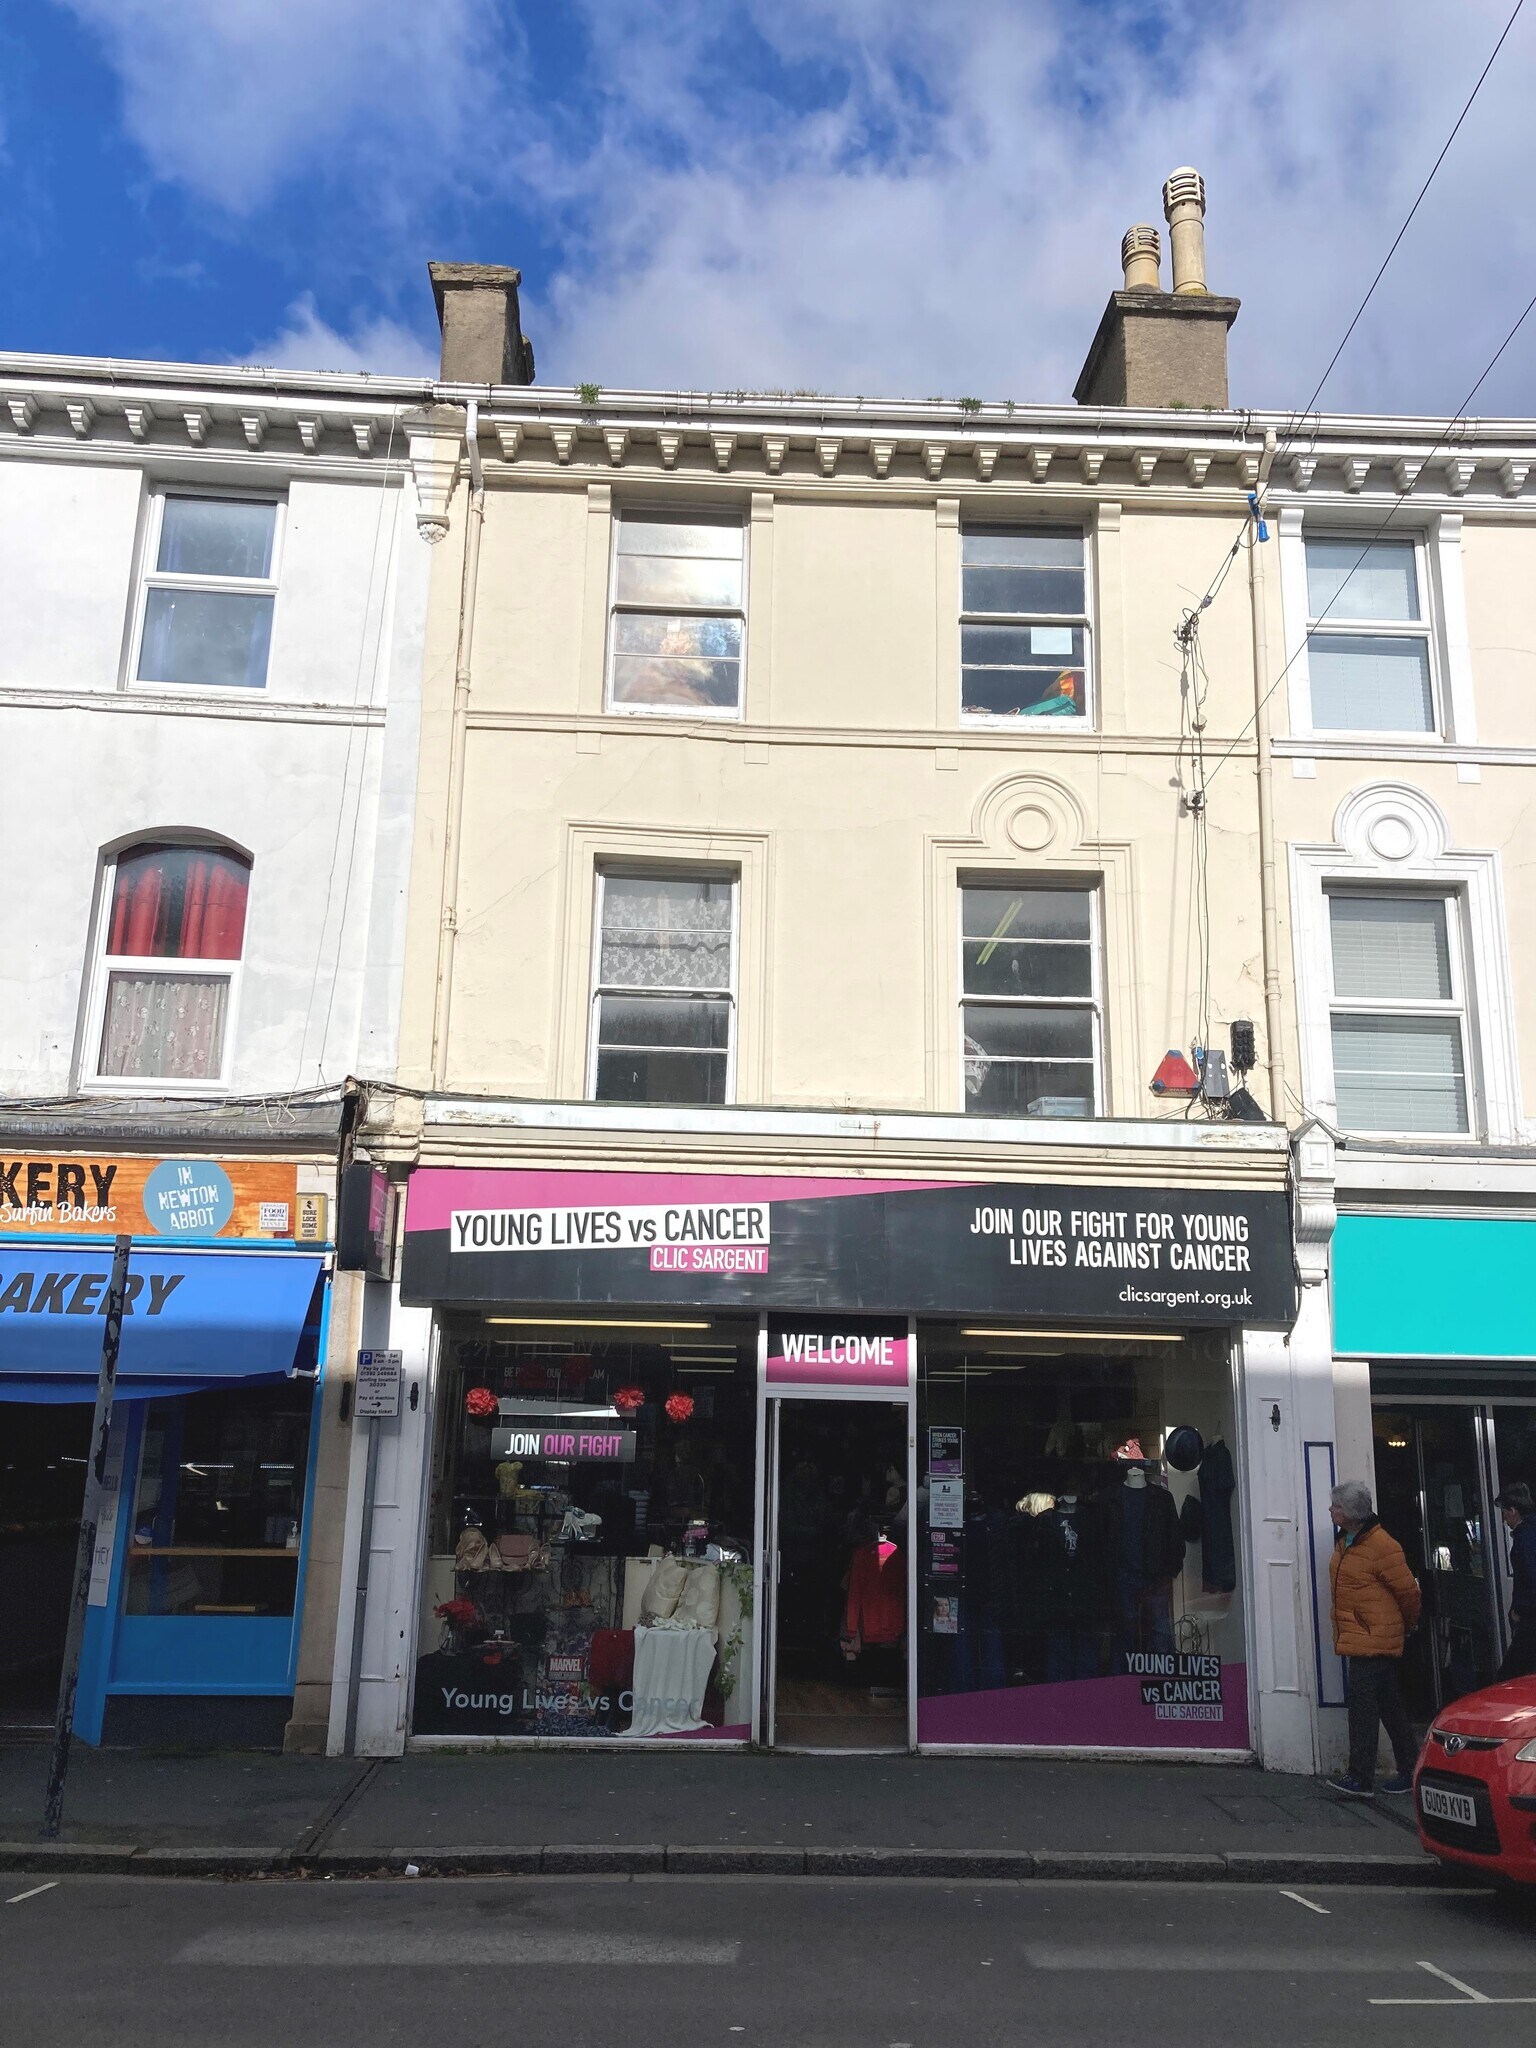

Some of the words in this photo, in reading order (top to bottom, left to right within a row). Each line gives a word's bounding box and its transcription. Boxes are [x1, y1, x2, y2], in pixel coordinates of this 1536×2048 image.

[0, 1162, 117, 1210] KERY
[178, 1166, 193, 1185] IN
[158, 1184, 220, 1211] NEWTON
[0, 1200, 53, 1225] Surfin
[57, 1200, 117, 1223] Bakers
[170, 1207, 215, 1231] ABBOT
[970, 1207, 1014, 1235] JOIN
[1022, 1208, 1062, 1237] OUR
[1070, 1210, 1128, 1239] FIGHT
[1136, 1213, 1176, 1240] FOR
[1181, 1213, 1249, 1242] YOUNG
[455, 1212, 542, 1247] YOUNG
[551, 1211, 621, 1244] LIVES
[628, 1218, 657, 1243] vs
[665, 1208, 764, 1241] CANCER
[653, 1248, 687, 1271] CLIC
[692, 1247, 766, 1271] SARGENT
[1009, 1238, 1067, 1267] LIVES
[1075, 1240, 1162, 1270] AGAINST
[1169, 1243, 1251, 1272] CANCER
[0, 1272, 186, 1316] AKERY
[1119, 1284, 1253, 1308] clicsargent.org.uk
[363, 1353, 371, 1364] P
[781, 1333, 894, 1365] WELCOME
[504, 1433, 540, 1456] JOIN
[543, 1434, 575, 1457] OUR
[578, 1434, 622, 1458] FIGHT
[550, 1657, 581, 1672] MARVEL
[1126, 1652, 1174, 1675] YOUNG
[1179, 1655, 1219, 1677] LIVES
[441, 1687, 514, 1715] Young
[522, 1688, 579, 1711] Lives
[587, 1693, 610, 1710] vs
[1143, 1686, 1160, 1702] vs
[1163, 1680, 1221, 1702] CANCER
[1157, 1705, 1178, 1719] CLIC
[1179, 1705, 1222, 1720] SARGENT
[1449, 1796, 1471, 1821] KVB
